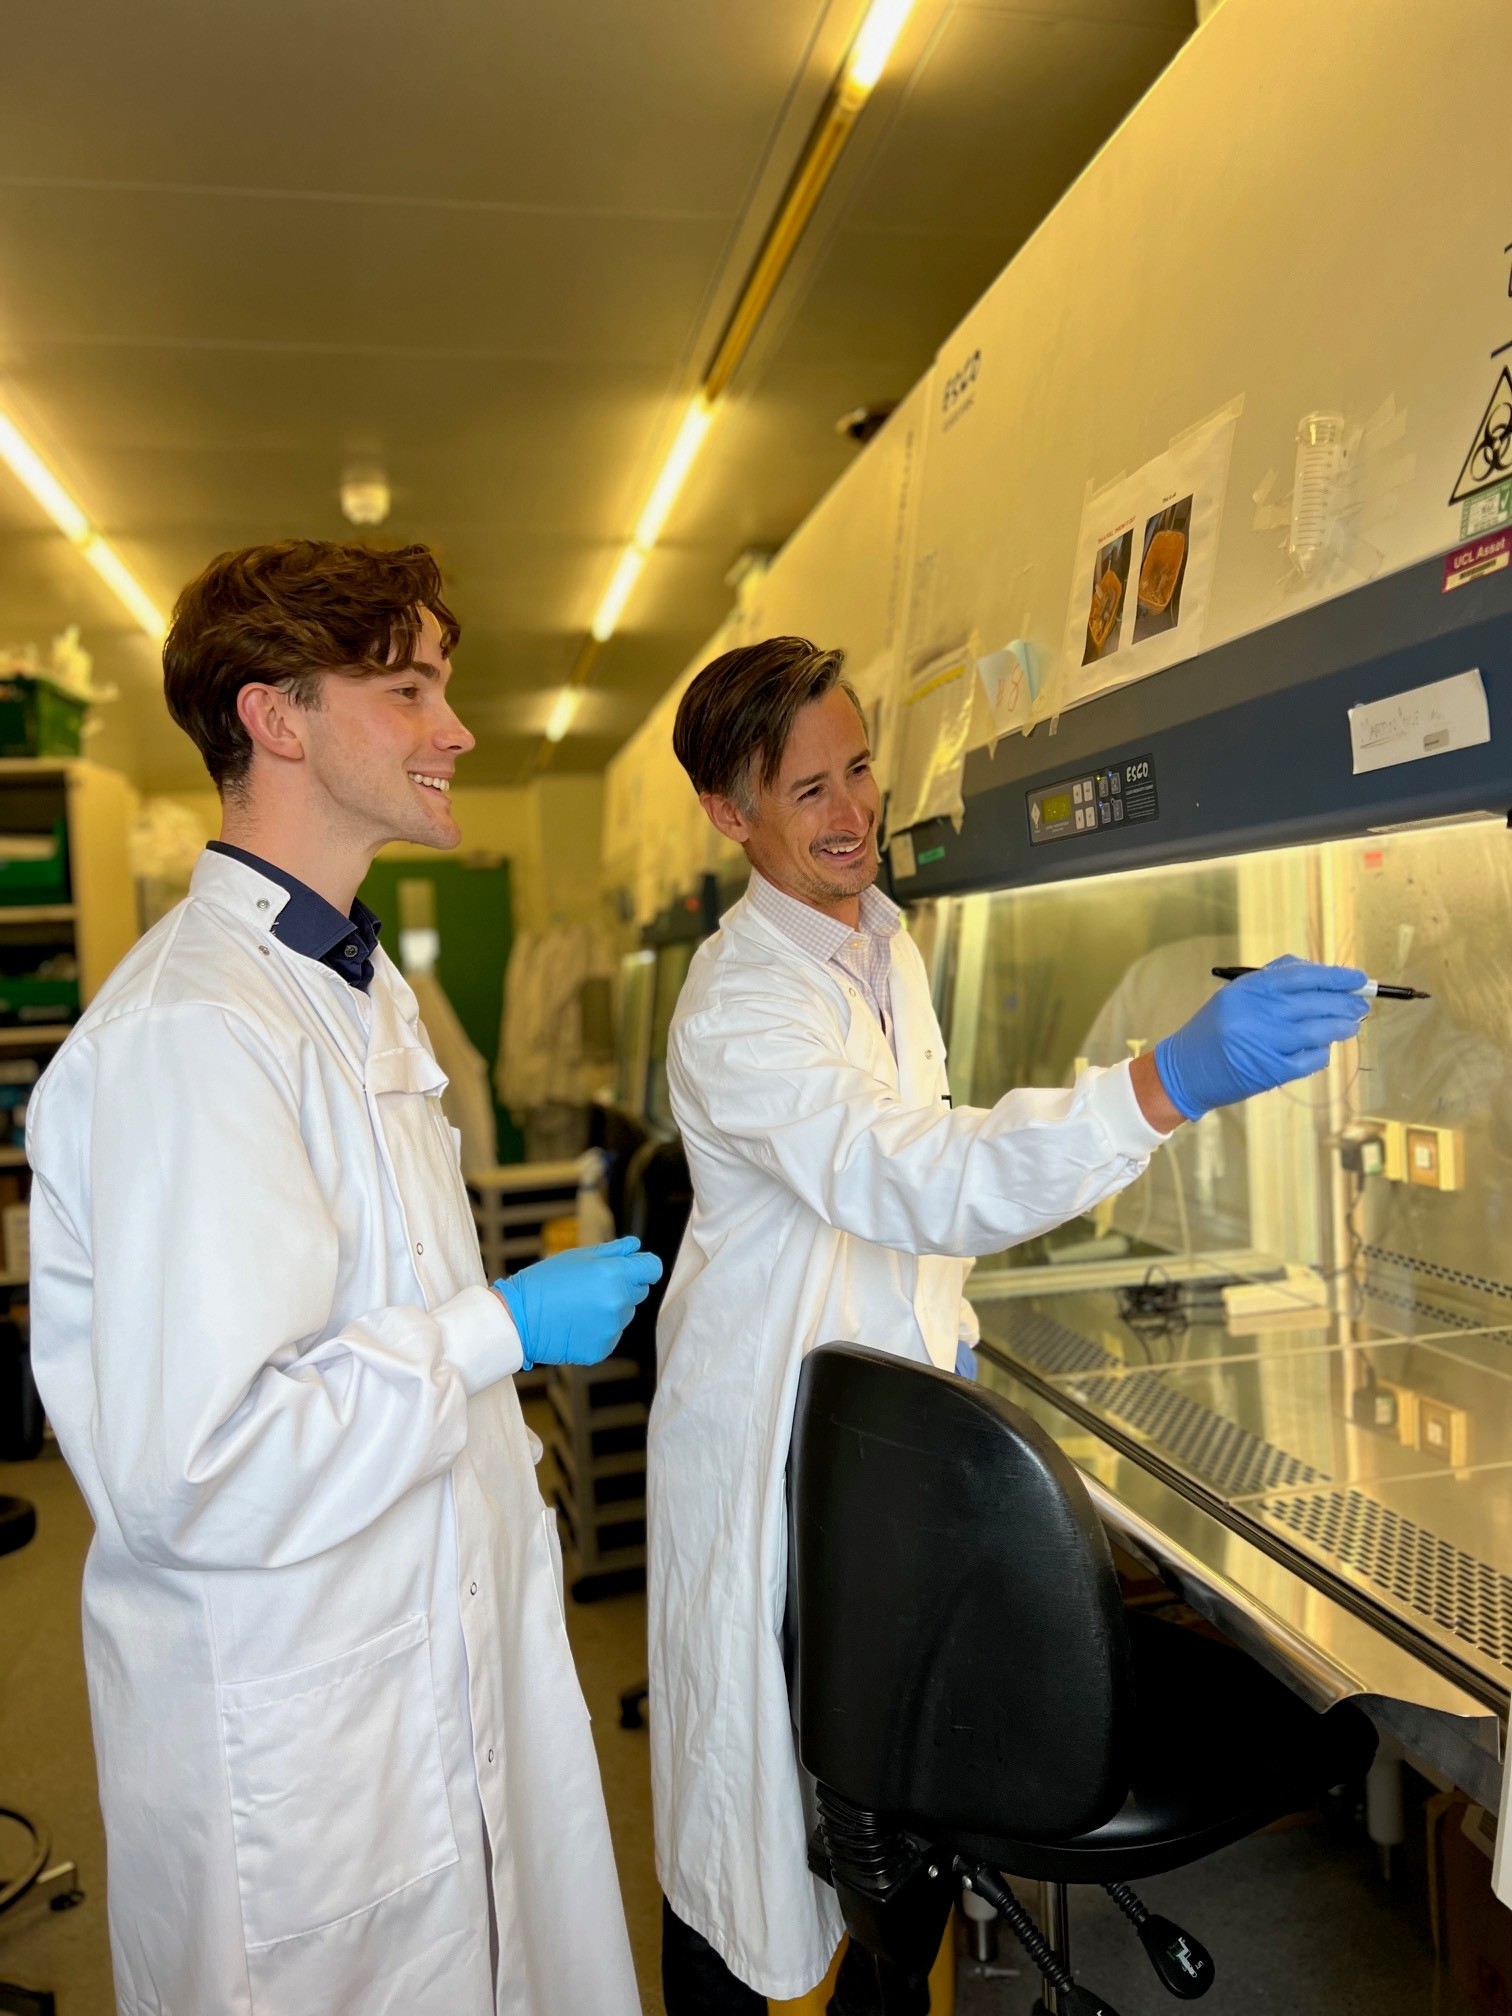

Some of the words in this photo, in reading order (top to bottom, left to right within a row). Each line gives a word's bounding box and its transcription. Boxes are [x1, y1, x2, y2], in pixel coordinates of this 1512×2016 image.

[1453, 550, 1474, 569] UCL
[1476, 537, 1506, 558] Asset
[1126, 761, 1149, 782] ESCO
